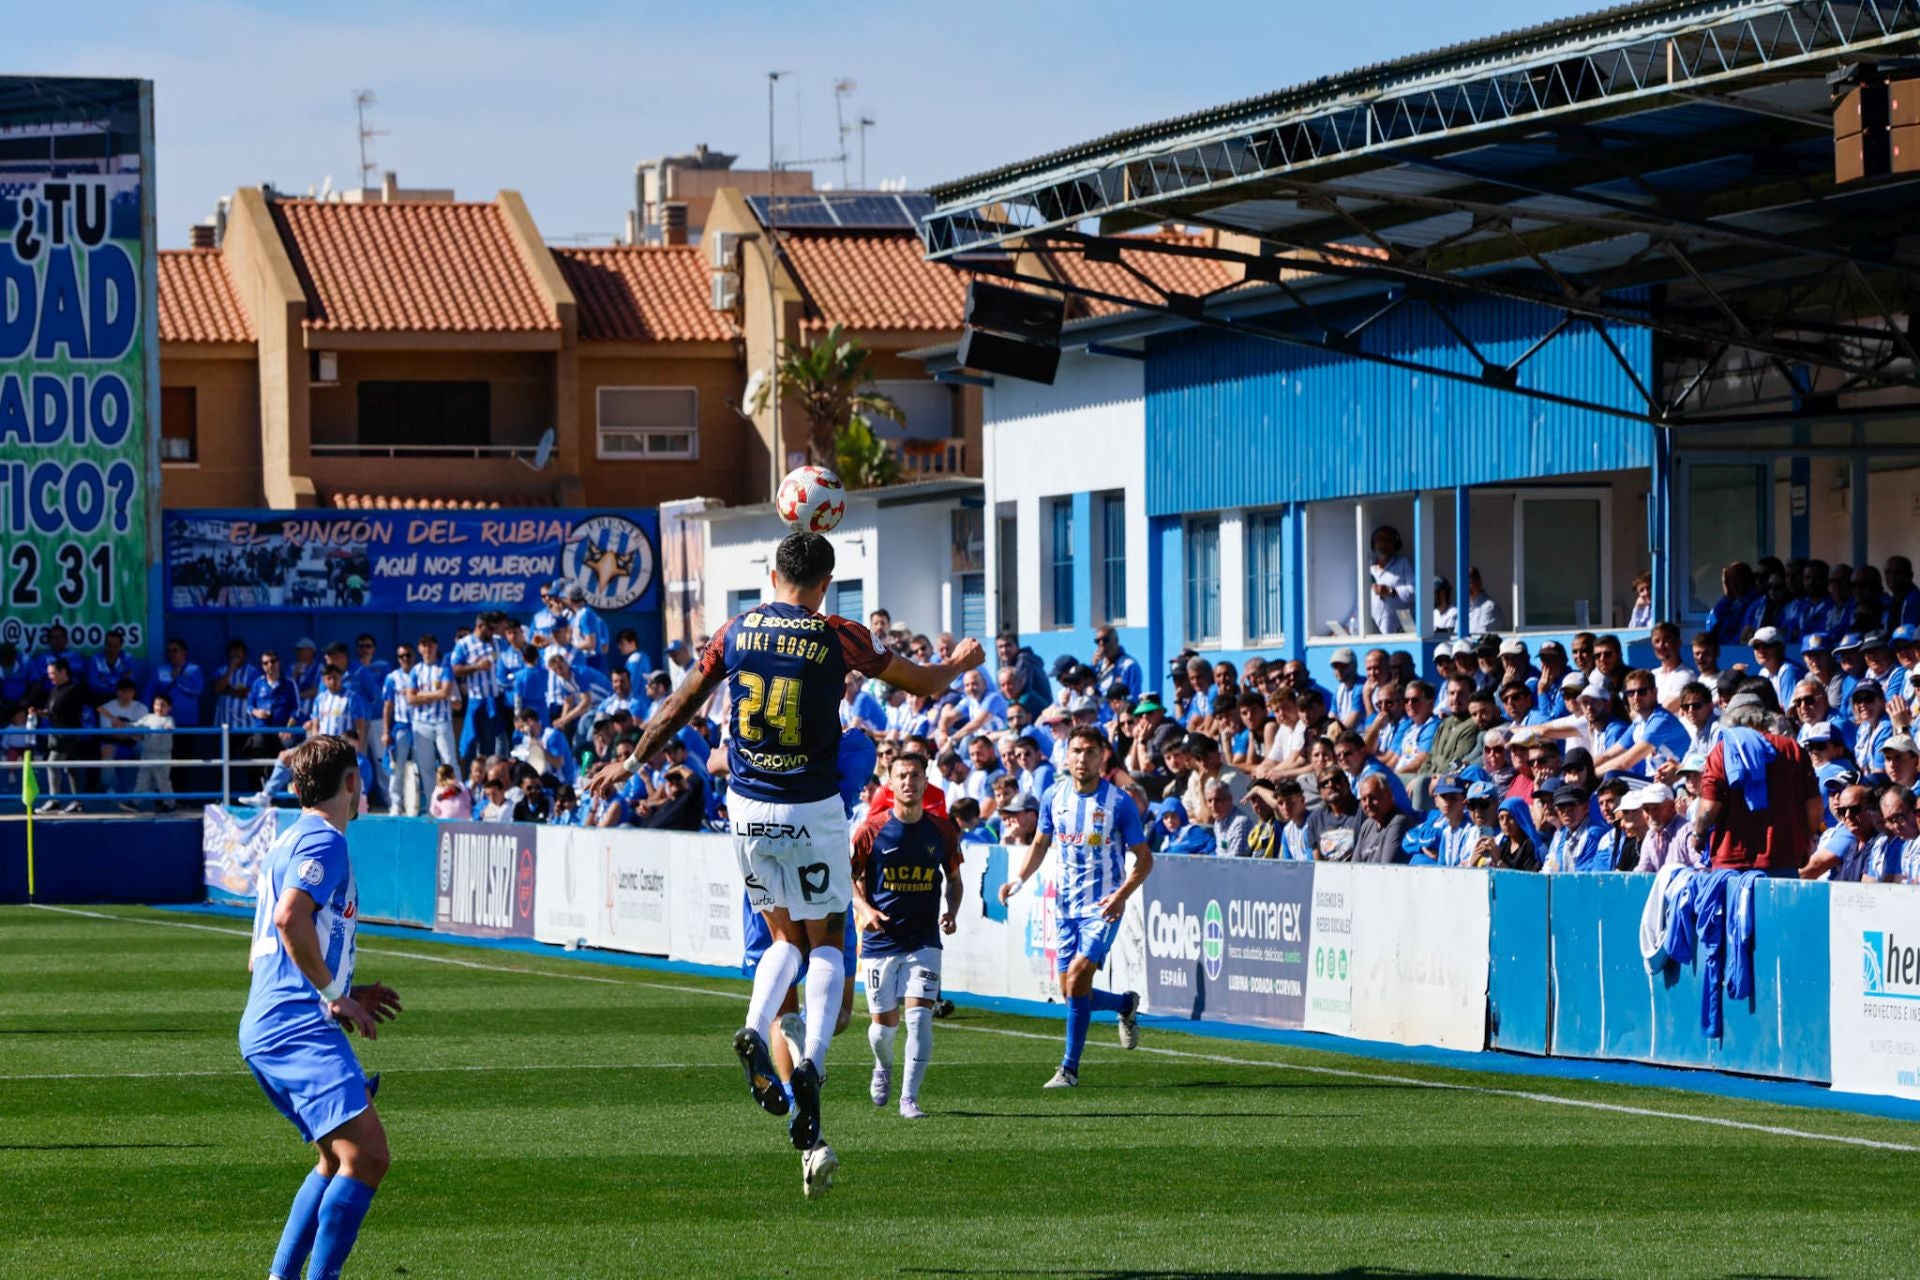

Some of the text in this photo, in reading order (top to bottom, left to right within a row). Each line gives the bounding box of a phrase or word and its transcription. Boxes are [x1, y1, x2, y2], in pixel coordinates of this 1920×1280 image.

[16, 183, 106, 261] ¿TU
[0, 243, 136, 358] DAD
[0, 374, 130, 445] ADIO
[229, 517, 581, 547] EL RINCÓN DEL RUBIAL
[58, 544, 111, 604] 31
[374, 553, 555, 578] AQUÍ NOS SALIERON
[406, 582, 525, 603] LOS DIENTES
[736, 631, 829, 664] MIKI BOSCH
[738, 670, 803, 746] 24
[737, 821, 811, 839] LIBERA
[867, 968, 880, 989] 16
[1160, 967, 1187, 988] ESPAÑA
[1863, 1003, 1902, 1019] PROYECTOS
